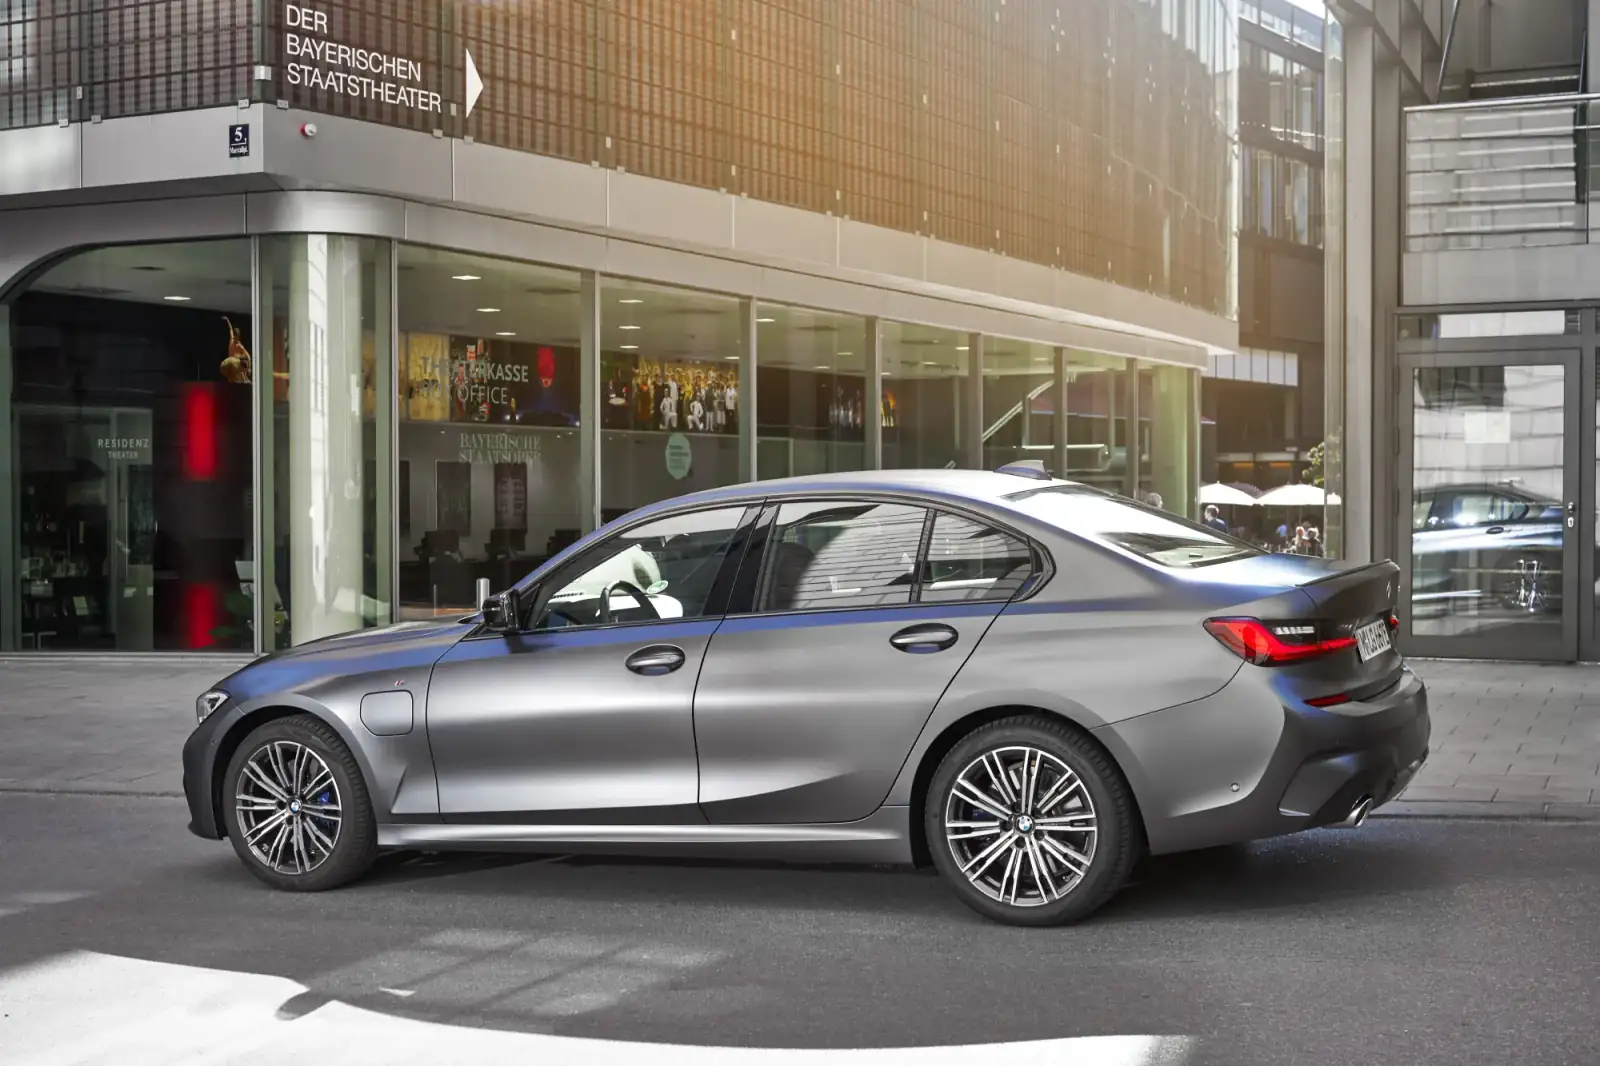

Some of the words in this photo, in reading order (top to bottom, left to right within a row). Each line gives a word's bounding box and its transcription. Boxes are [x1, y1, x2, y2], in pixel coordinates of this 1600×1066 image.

[286, 4, 328, 34] DER
[286, 33, 421, 82] BAYERISCHEN
[287, 62, 442, 113] STAATSTHEATER
[234, 126, 243, 142] 5
[421, 357, 529, 383] THEATERKASSE
[457, 384, 509, 405] OFFICE
[97, 438, 150, 449] RESIDENZ
[460, 432, 541, 451] BAYERISCHE
[108, 450, 139, 460] THEATER
